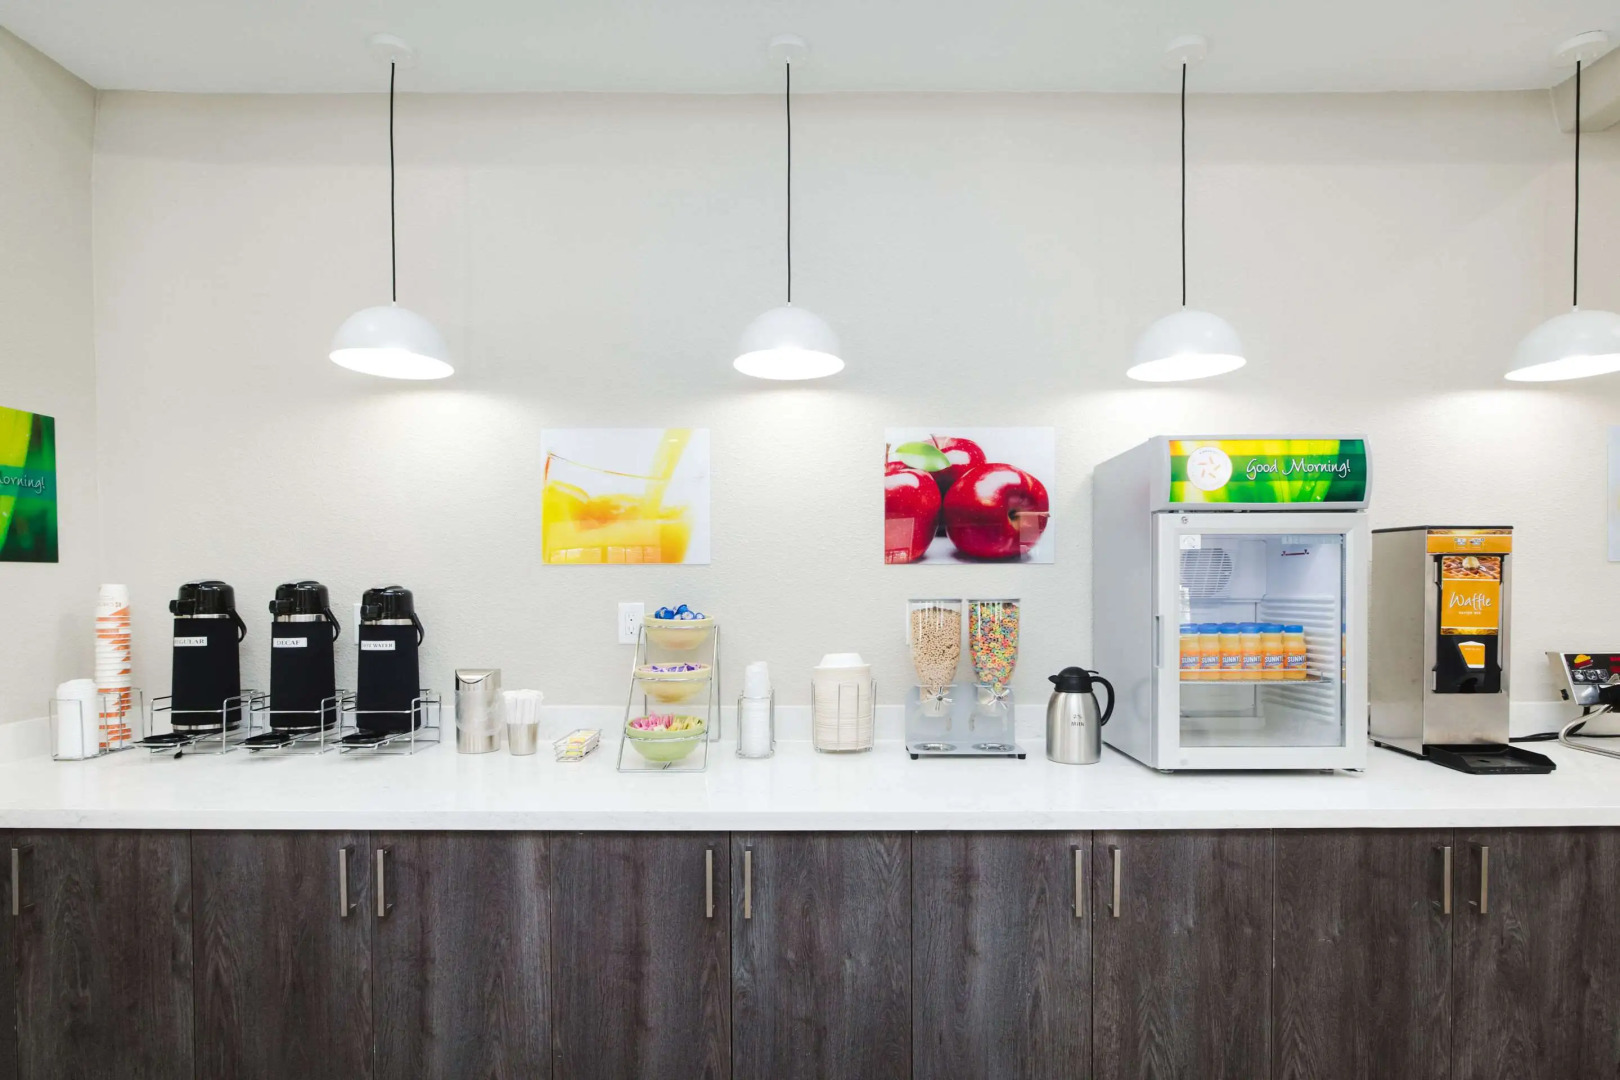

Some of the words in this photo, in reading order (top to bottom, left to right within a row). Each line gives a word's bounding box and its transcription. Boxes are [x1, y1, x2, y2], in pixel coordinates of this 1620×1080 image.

[1246, 458, 1278, 480] Good
[1282, 458, 1351, 478] Morning!
[1449, 592, 1491, 610] Waffle
